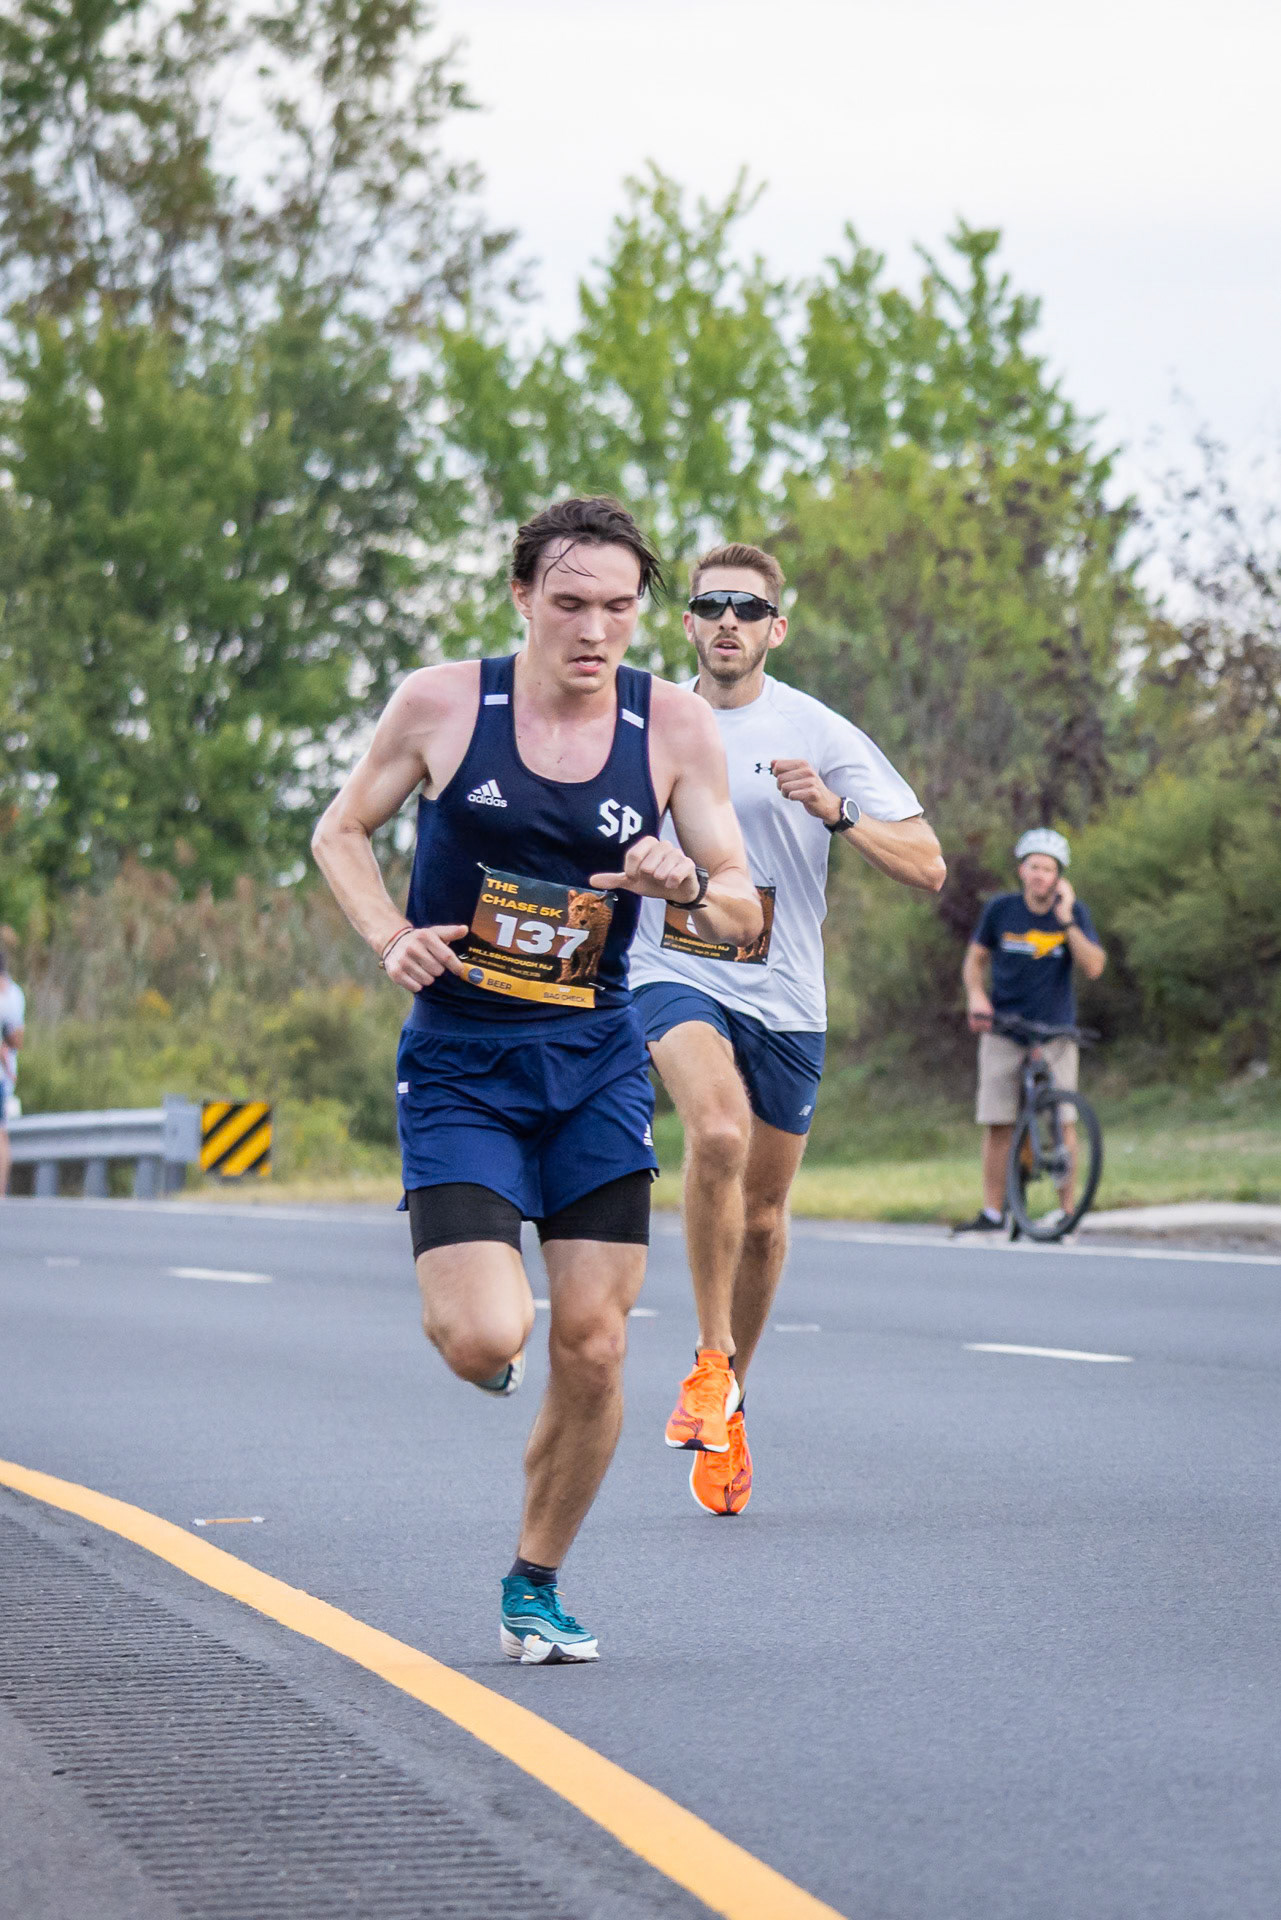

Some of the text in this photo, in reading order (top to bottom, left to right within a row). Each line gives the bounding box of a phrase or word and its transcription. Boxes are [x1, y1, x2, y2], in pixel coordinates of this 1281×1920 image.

[467, 793, 508, 808] adidas
[486, 878, 520, 895] THE
[481, 893, 564, 919] CHASE 5K
[495, 913, 590, 960] 137
[468, 946, 539, 968] HILLSBOROUGH
[539, 963, 554, 971] NJ
[486, 978, 512, 991] BEER
[543, 992, 560, 1000] BAG
